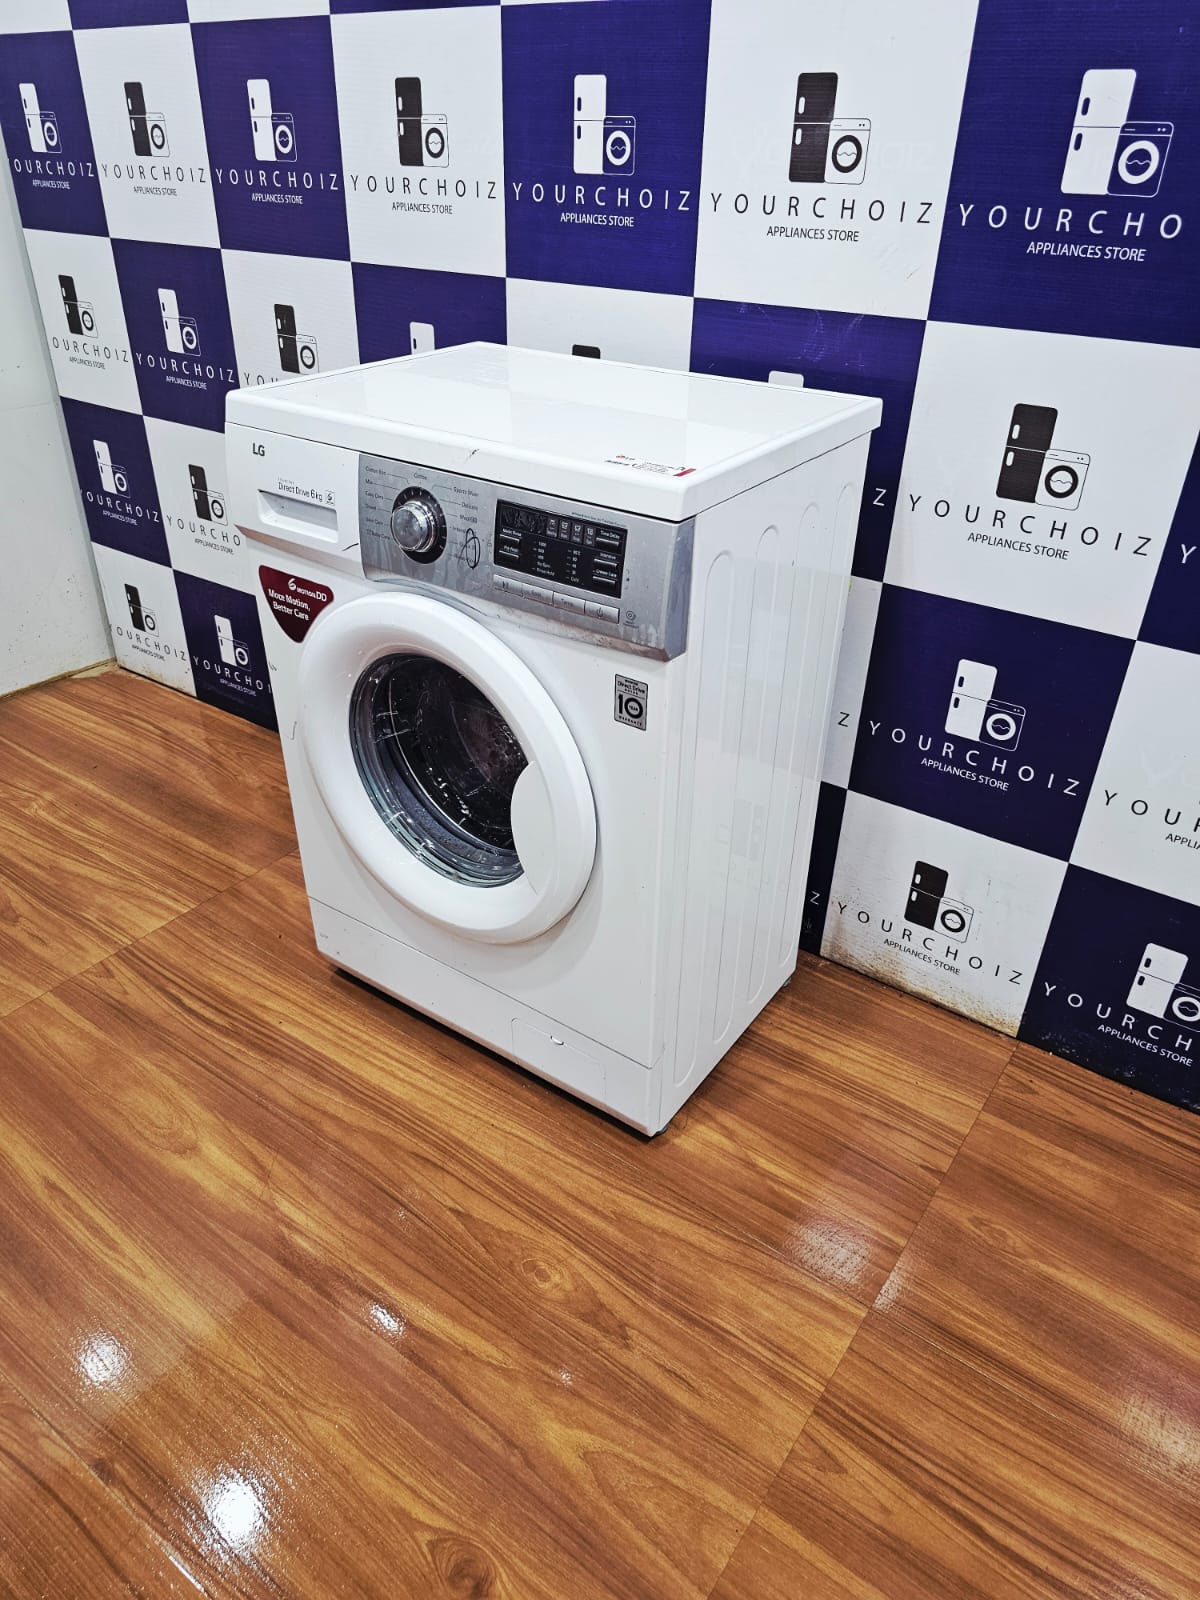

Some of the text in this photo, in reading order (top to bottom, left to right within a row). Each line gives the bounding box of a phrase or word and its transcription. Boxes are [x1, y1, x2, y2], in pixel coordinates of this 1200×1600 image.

[8, 158, 95, 177] OURCHOIZ
[101, 163, 208, 183] YOURCHOIZ
[216, 168, 339, 190] YOURCHOIZ
[133, 185, 178, 196] APPLIANCES STORE
[252, 192, 303, 205] APPLIANCES STORE
[350, 175, 497, 199] YOURCHOIZ
[513, 182, 691, 211] YOURCHOIZ
[392, 201, 453, 214] APPLIANCES STORE
[560, 212, 635, 227] APPLIANCES STORE
[711, 193, 934, 224] YOURCHOIZ
[767, 225, 860, 242] APPLIANCES STORE
[959, 203, 1183, 240] YOURCHO
[1027, 241, 1146, 262] APPLIANCES STORE
[135, 352, 235, 383] YOURCHOIZ
[243, 372, 279, 385] YO
[252, 442, 265, 457] LG
[166, 515, 241, 546] YOURCHO
[909, 494, 1152, 556] YOURCHOIZ
[967, 531, 1070, 560] APPLIANCES STORE
[268, 588, 285, 602] More
[273, 601, 309, 621] Better Care
[109, 624, 187, 661] OURCHOIZ
[618, 693, 643, 719] 10
[869, 720, 1080, 796] YOURCHOIZ
[920, 757, 1010, 792] APPLIANCES STORE
[837, 902, 1023, 985] YOURCHOIZ
[883, 938, 961, 976] APPLIANCES STORE
[1044, 981, 1193, 1052] YOURCH
[1097, 1024, 1193, 1067] APPLIANCES STORE
